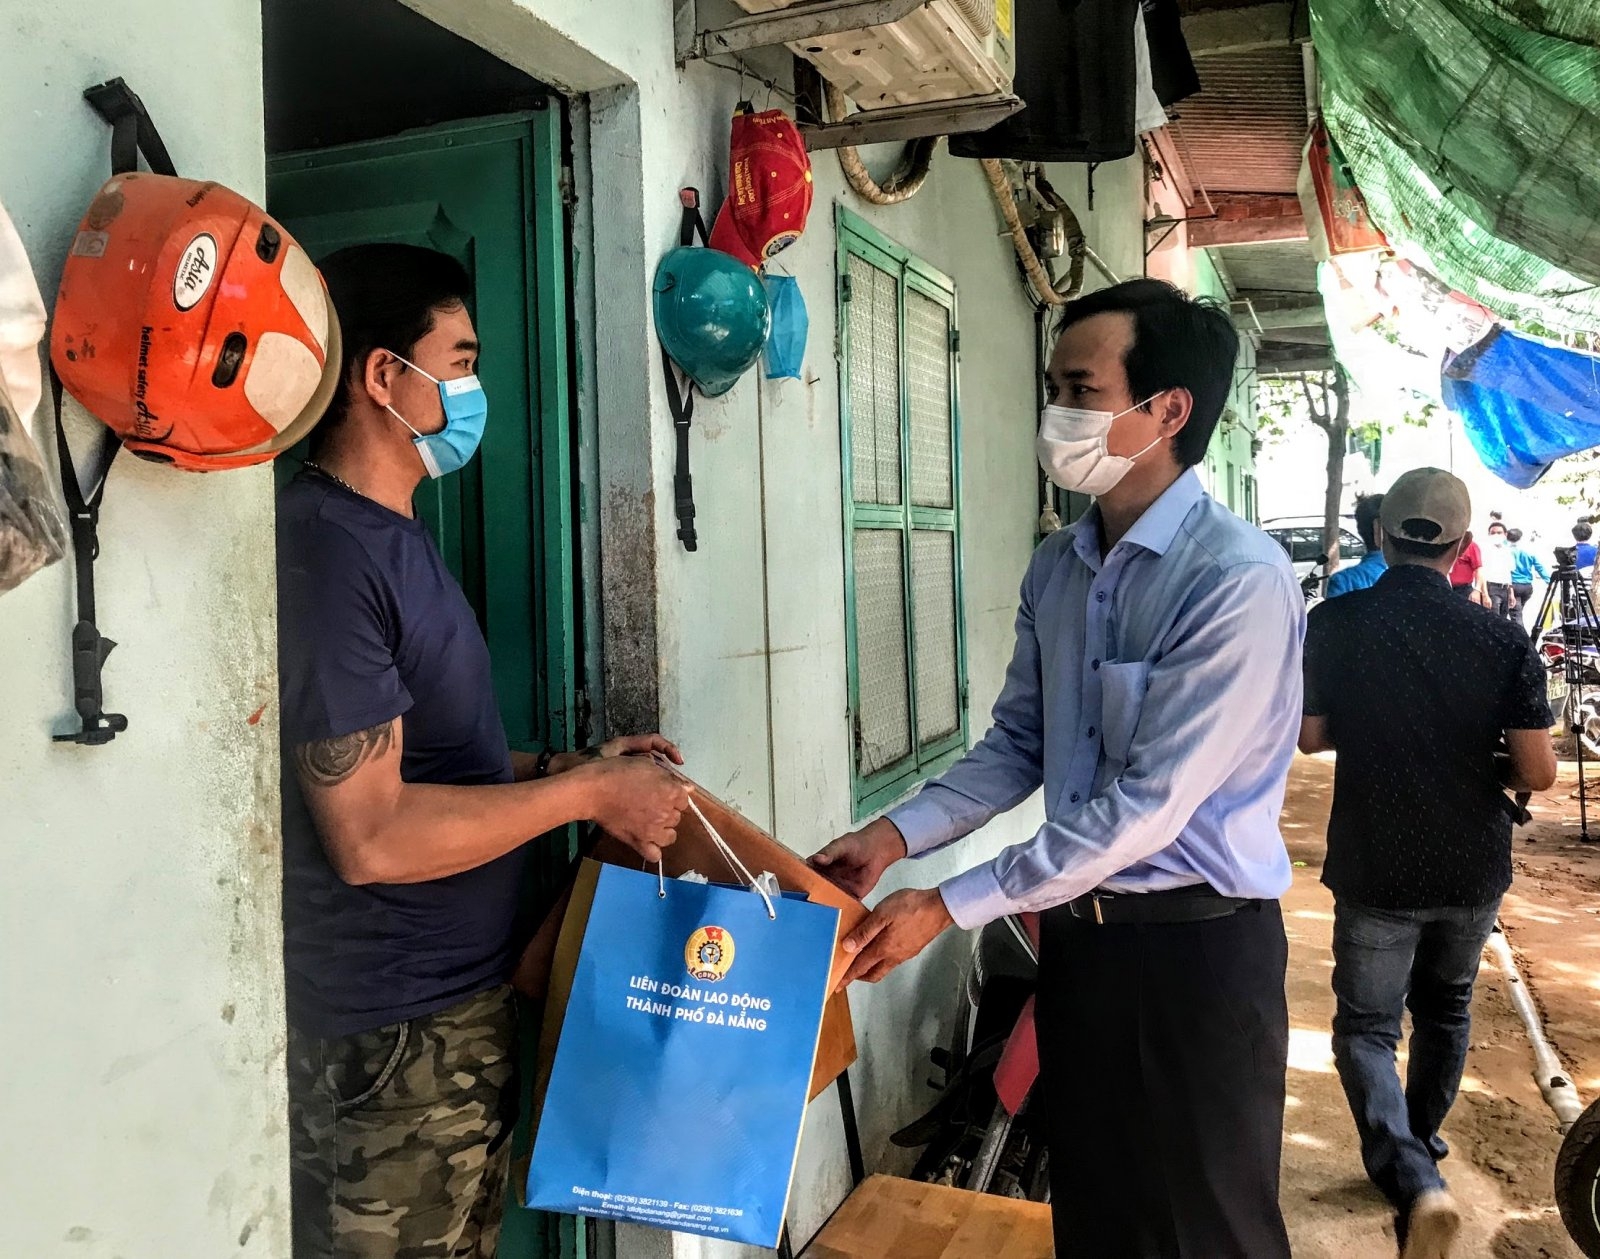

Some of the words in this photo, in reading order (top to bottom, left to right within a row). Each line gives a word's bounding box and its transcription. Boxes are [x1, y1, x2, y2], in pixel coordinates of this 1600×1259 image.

[184, 246, 210, 290] Asia
[138, 326, 154, 367] helmet
[134, 369, 149, 400] safety
[630, 976, 658, 993] LIÊN
[661, 981, 702, 1002] ĐOÀN
[703, 990, 728, 1005] LAO
[731, 992, 771, 1011] ĐỘNG
[626, 995, 671, 1018] THÀNH
[674, 1006, 707, 1023] PHỐ
[706, 1010, 725, 1026] ĐÀ
[727, 1010, 767, 1031] NẴNG
[572, 1185, 590, 1197] Điện
[591, 1190, 613, 1201] thoại:
[614, 1195, 638, 1205] (0236)
[638, 1198, 669, 1208] 3821139
[673, 1202, 690, 1210] Fax:
[690, 1203, 713, 1215] (0236)
[601, 1201, 625, 1211] Email:
